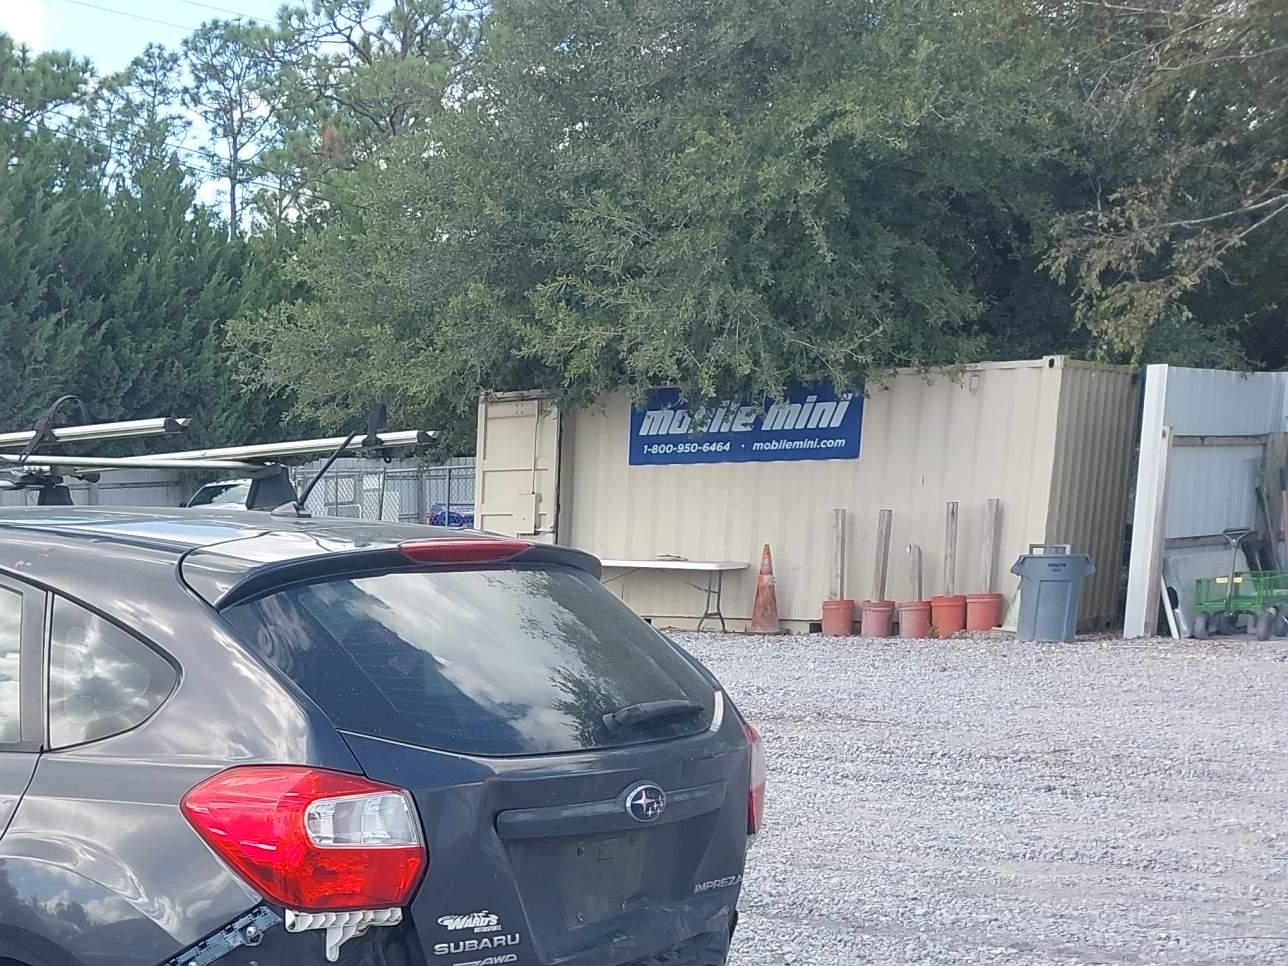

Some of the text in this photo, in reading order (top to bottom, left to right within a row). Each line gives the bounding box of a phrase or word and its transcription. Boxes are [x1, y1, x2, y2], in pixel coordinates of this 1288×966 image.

[761, 393, 853, 431] mini
[643, 437, 846, 454] 1-800-950-6464 mobilemini.com
[694, 874, 743, 894] IMPREZA
[433, 933, 520, 955] SUBARU
[479, 954, 518, 966] AWD
